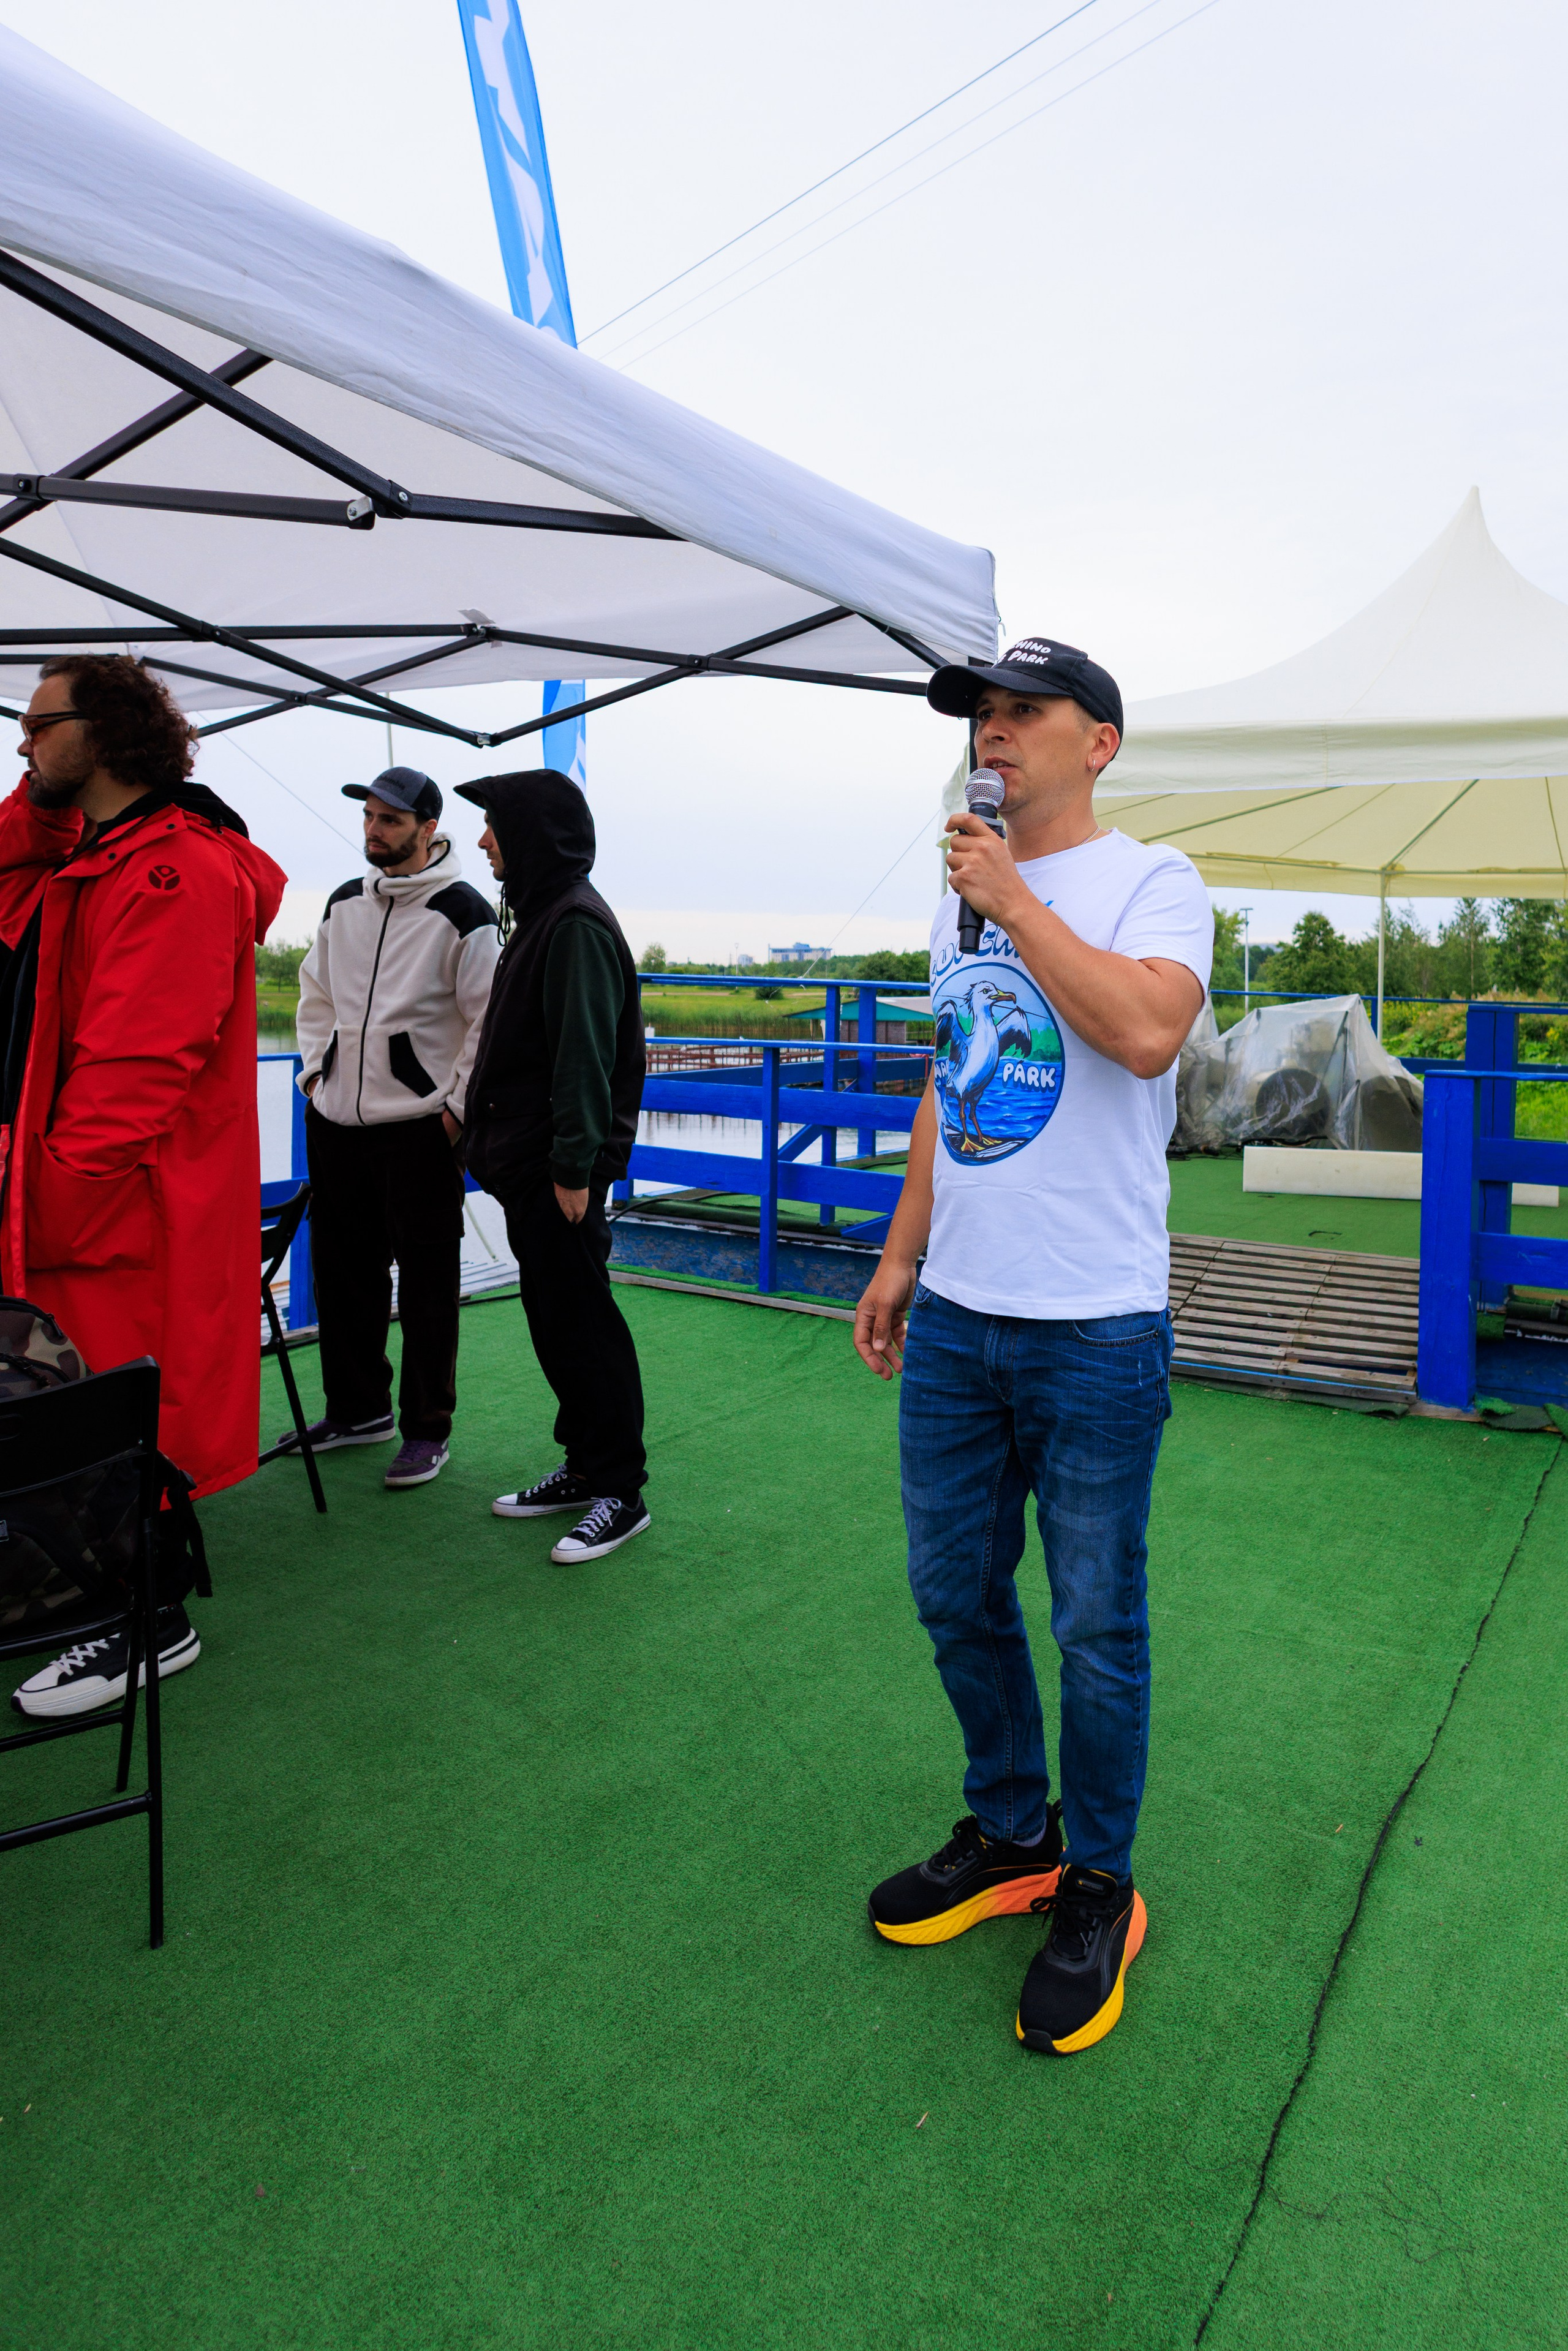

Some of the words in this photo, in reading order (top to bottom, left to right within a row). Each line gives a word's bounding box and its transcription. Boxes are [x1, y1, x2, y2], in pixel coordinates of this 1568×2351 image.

[1010, 640, 1052, 654] HINO
[1008, 650, 1049, 665] PARK
[1003, 1063, 1056, 1089] PARK
